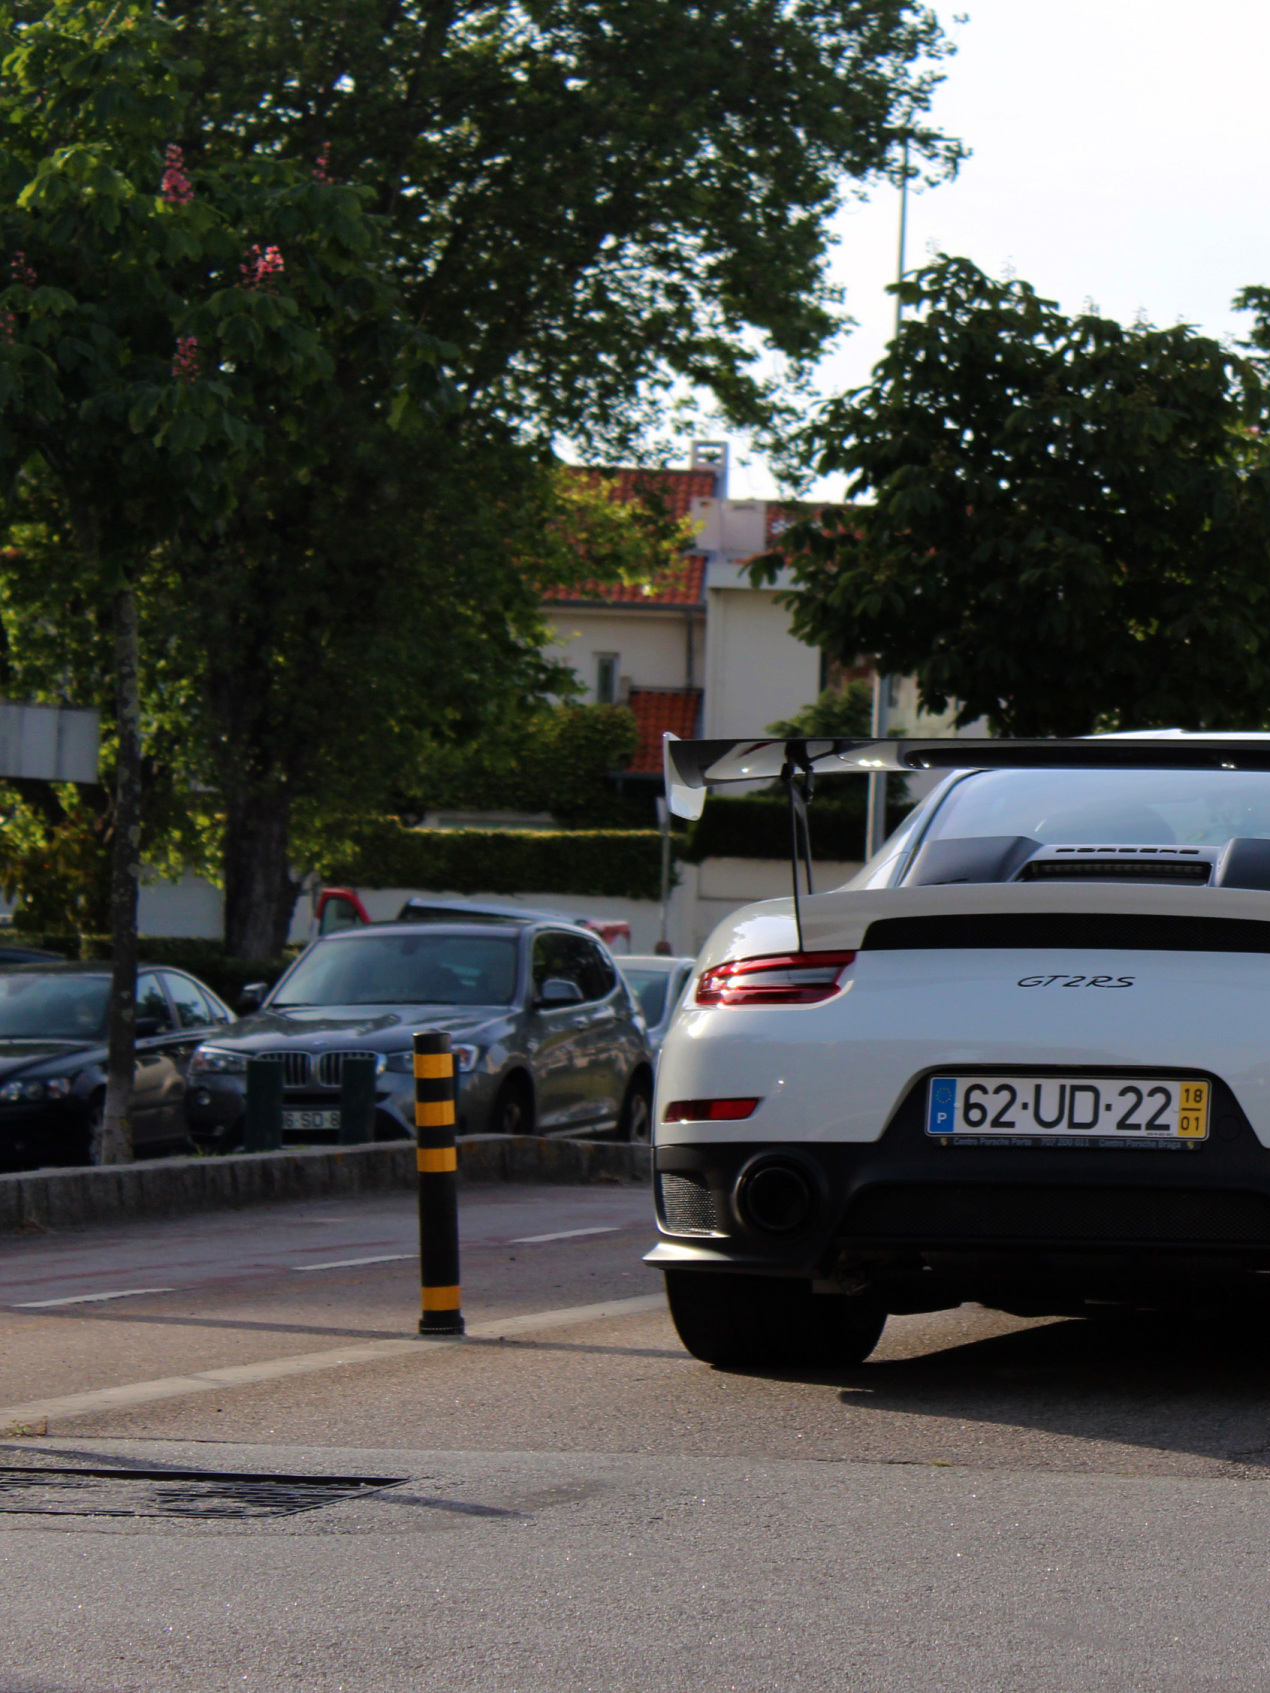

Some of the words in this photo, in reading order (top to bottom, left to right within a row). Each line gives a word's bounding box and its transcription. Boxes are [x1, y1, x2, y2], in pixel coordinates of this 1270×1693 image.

[1184, 1087, 1204, 1103] 18
[937, 1112, 947, 1124] P
[1180, 1116, 1200, 1132] 01
[953, 1137, 978, 1146] Centro
[980, 1137, 1010, 1146] Porsche
[1011, 1138, 1032, 1146] Porto
[1041, 1138, 1055, 1147] 707
[1057, 1138, 1073, 1147] 200
[1074, 1138, 1089, 1147] 011
[1099, 1139, 1124, 1148] Centro
[1125, 1140, 1156, 1148] Porsche
[1158, 1140, 1181, 1149] Braga
